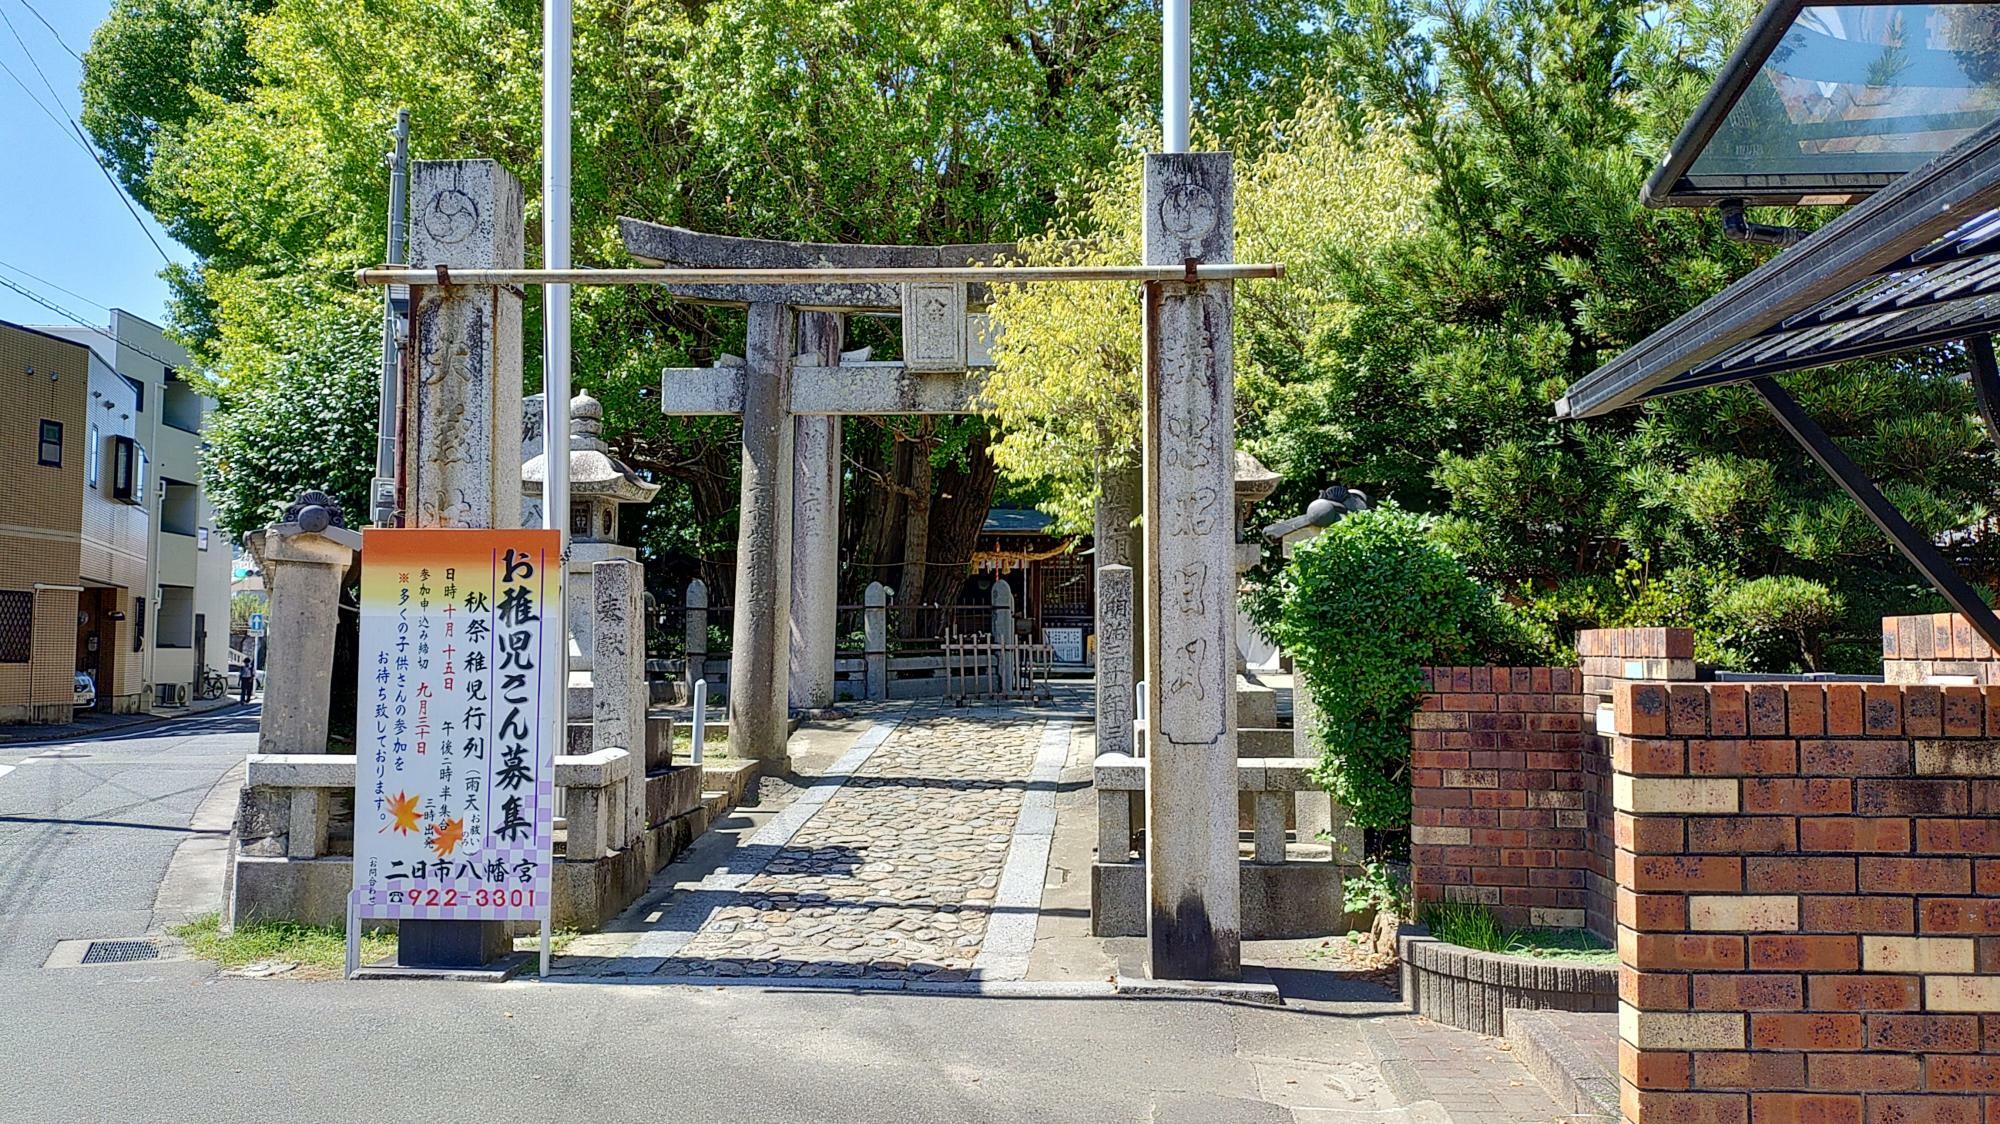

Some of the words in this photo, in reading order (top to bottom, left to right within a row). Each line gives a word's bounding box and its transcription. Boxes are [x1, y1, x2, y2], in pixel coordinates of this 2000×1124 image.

[417, 568, 431, 670] 参加申込み締切
[415, 682, 433, 756] 九月三十日
[462, 591, 491, 760] 秋祭稚児行列
[493, 548, 541, 843] お稚児さん募集
[374, 651, 391, 821] お待ち致しております。
[439, 721, 455, 831] 午後二時半集合
[385, 858, 538, 883] 二日市八幡宮
[423, 798, 437, 849] 三時出発
[408, 888, 535, 908] 922-3301
